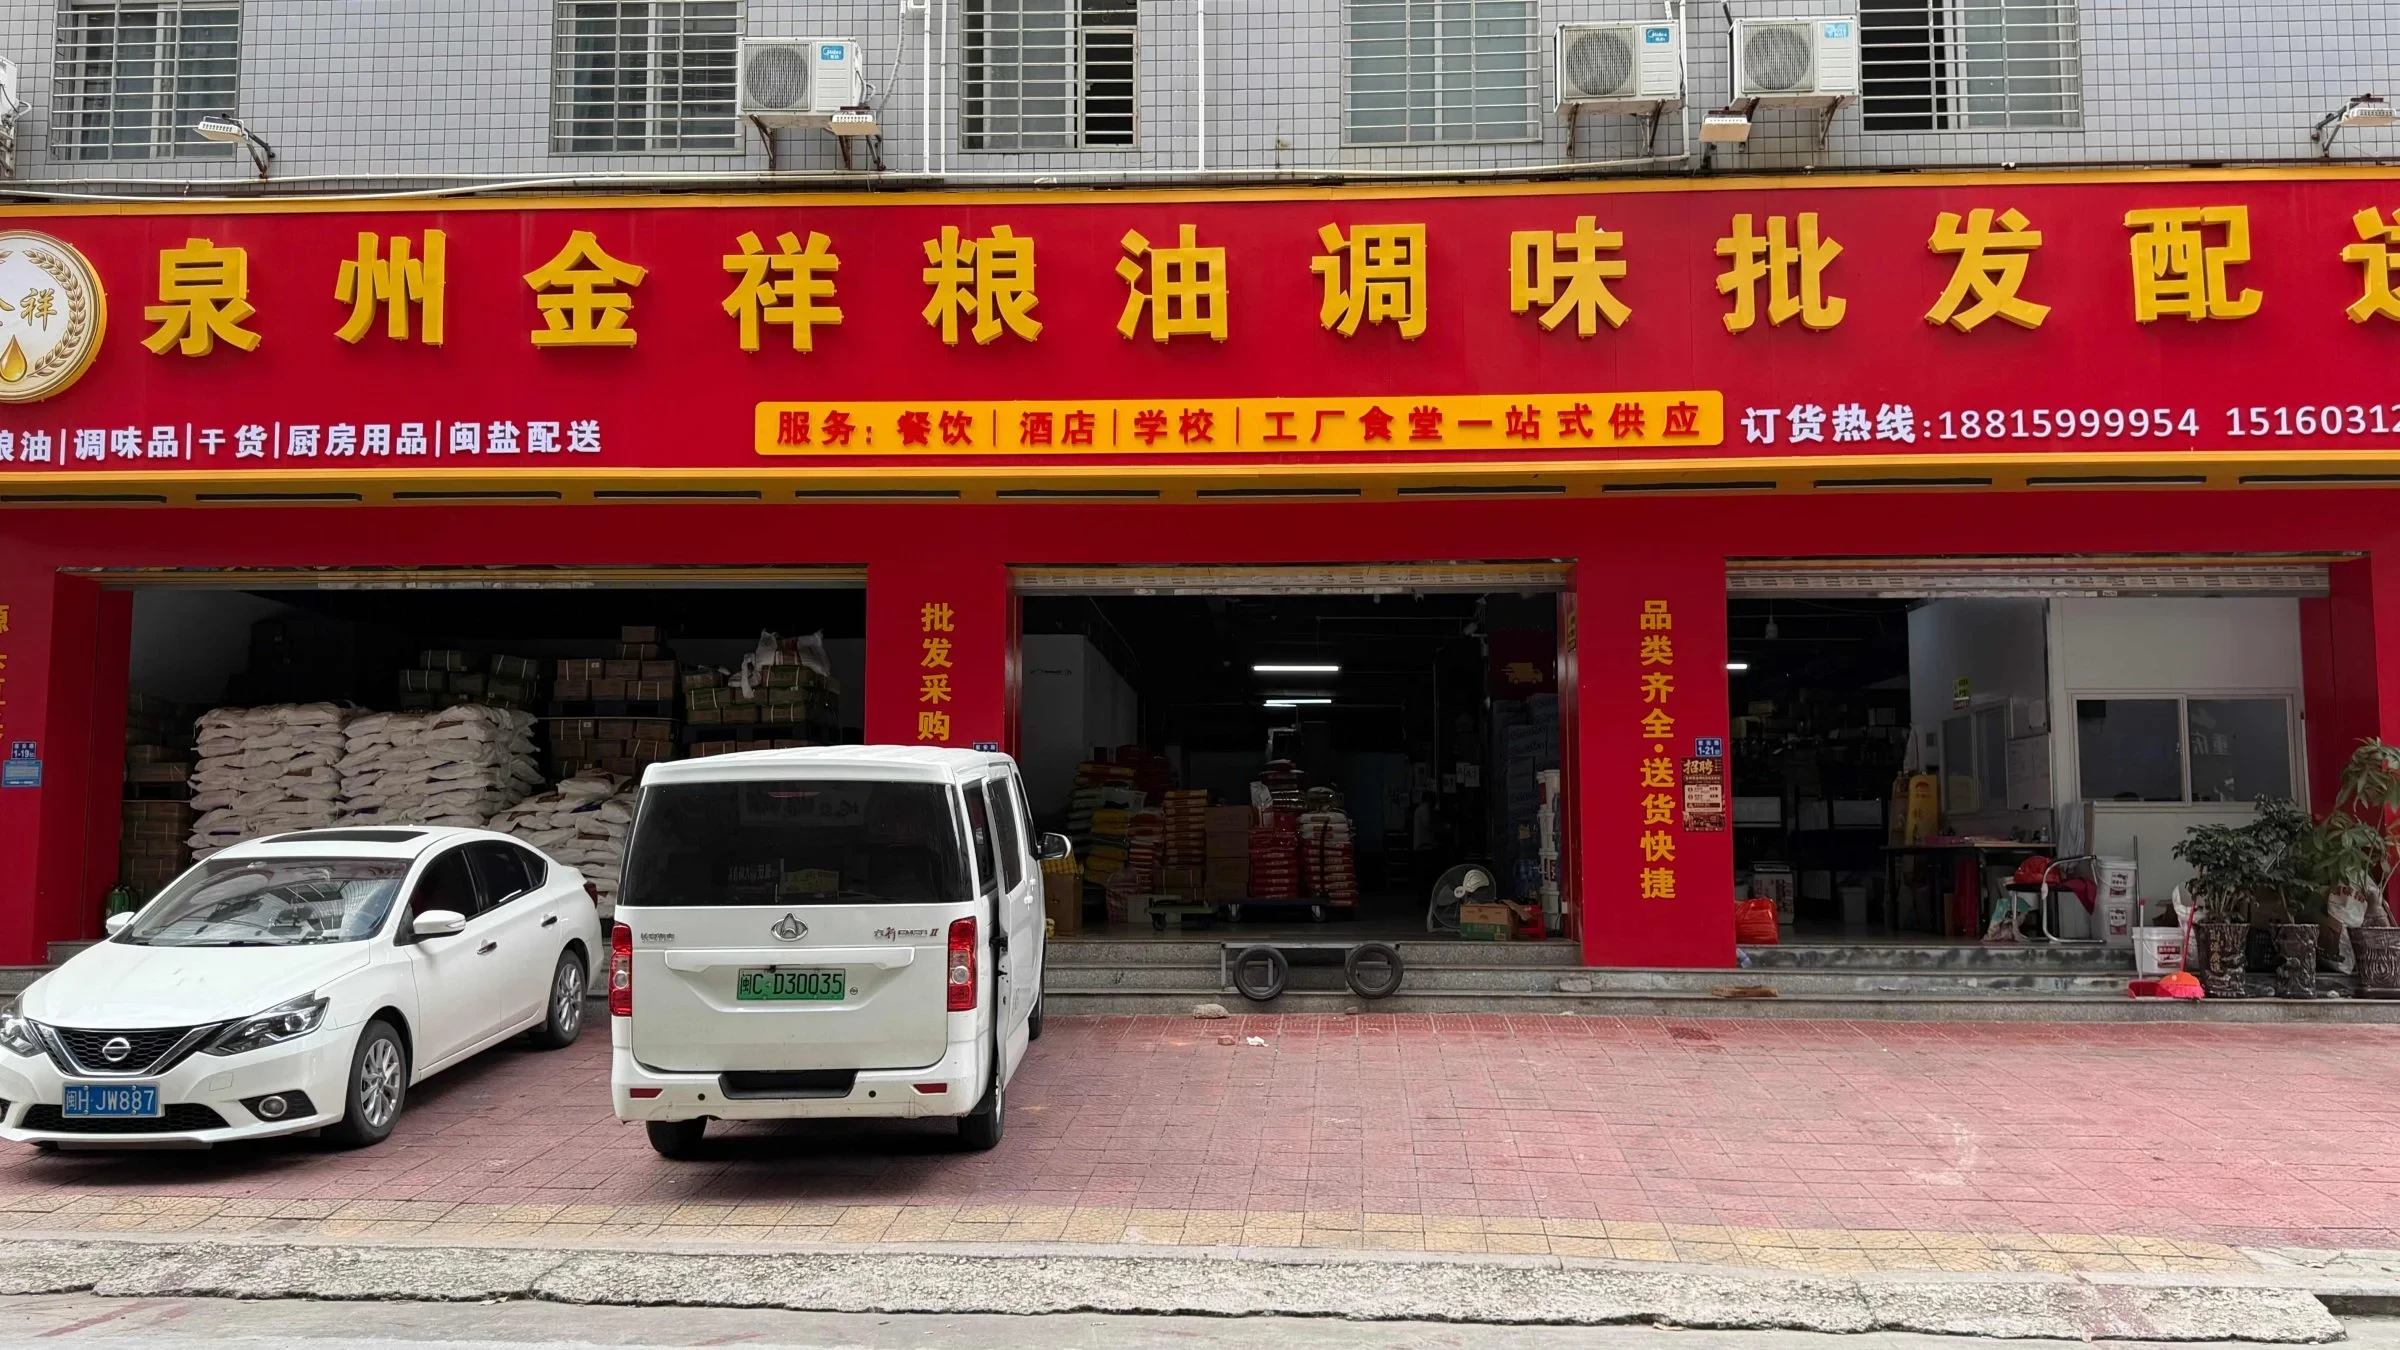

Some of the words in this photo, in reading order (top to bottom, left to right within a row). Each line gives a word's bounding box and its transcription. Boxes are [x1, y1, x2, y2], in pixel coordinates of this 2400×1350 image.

[73, 425, 179, 461] 调味品
[286, 423, 427, 457] 厨房用品
[449, 419, 602, 455] 闽盐配送
[1263, 401, 1701, 442] 工厂食堂一站式供应
[917, 602, 954, 741] 批发采购
[1683, 758, 1714, 776] 招聘
